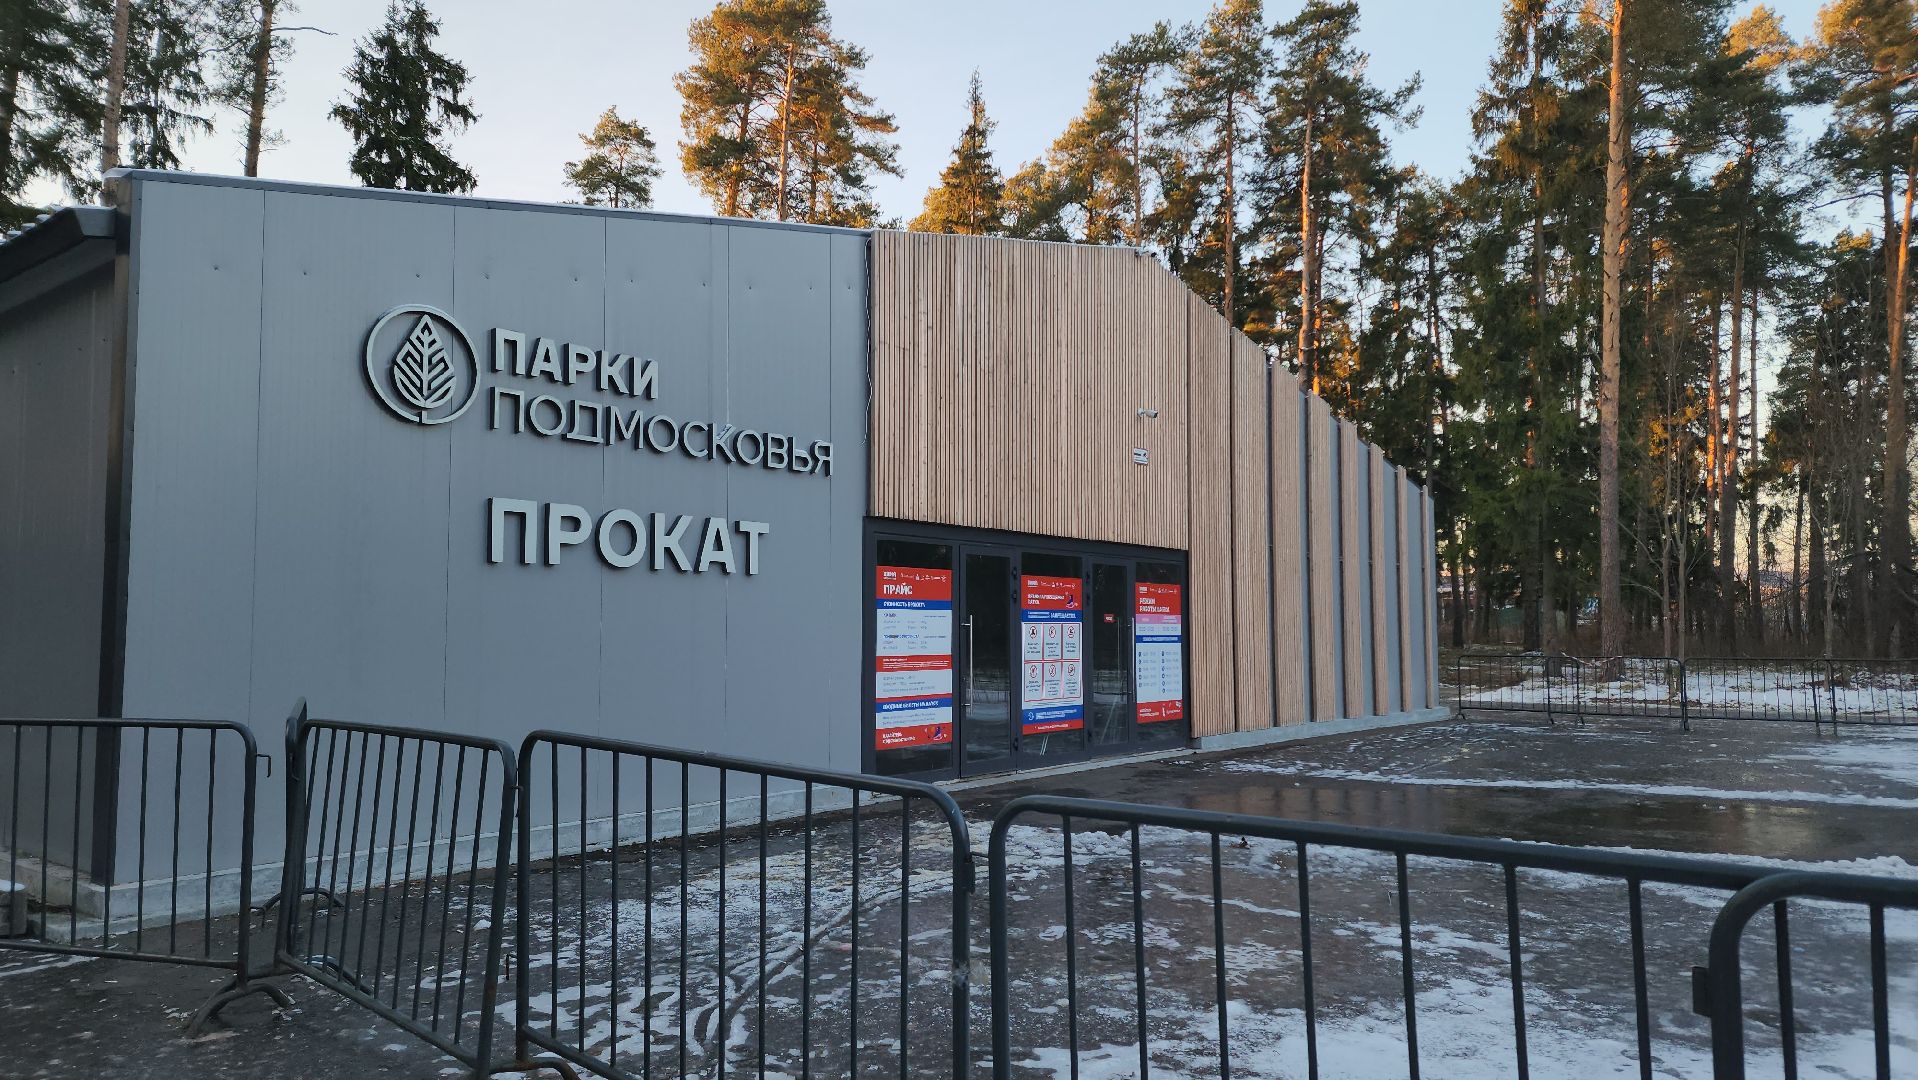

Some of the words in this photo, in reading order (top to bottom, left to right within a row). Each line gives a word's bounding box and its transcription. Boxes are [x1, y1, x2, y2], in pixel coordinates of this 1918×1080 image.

[490, 327, 659, 400] ПАРКИ
[489, 386, 833, 477] ПОДМОСКОВЬЯ
[487, 497, 770, 575] ПРОКАТ
[883, 582, 913, 595] ПРАЙС
